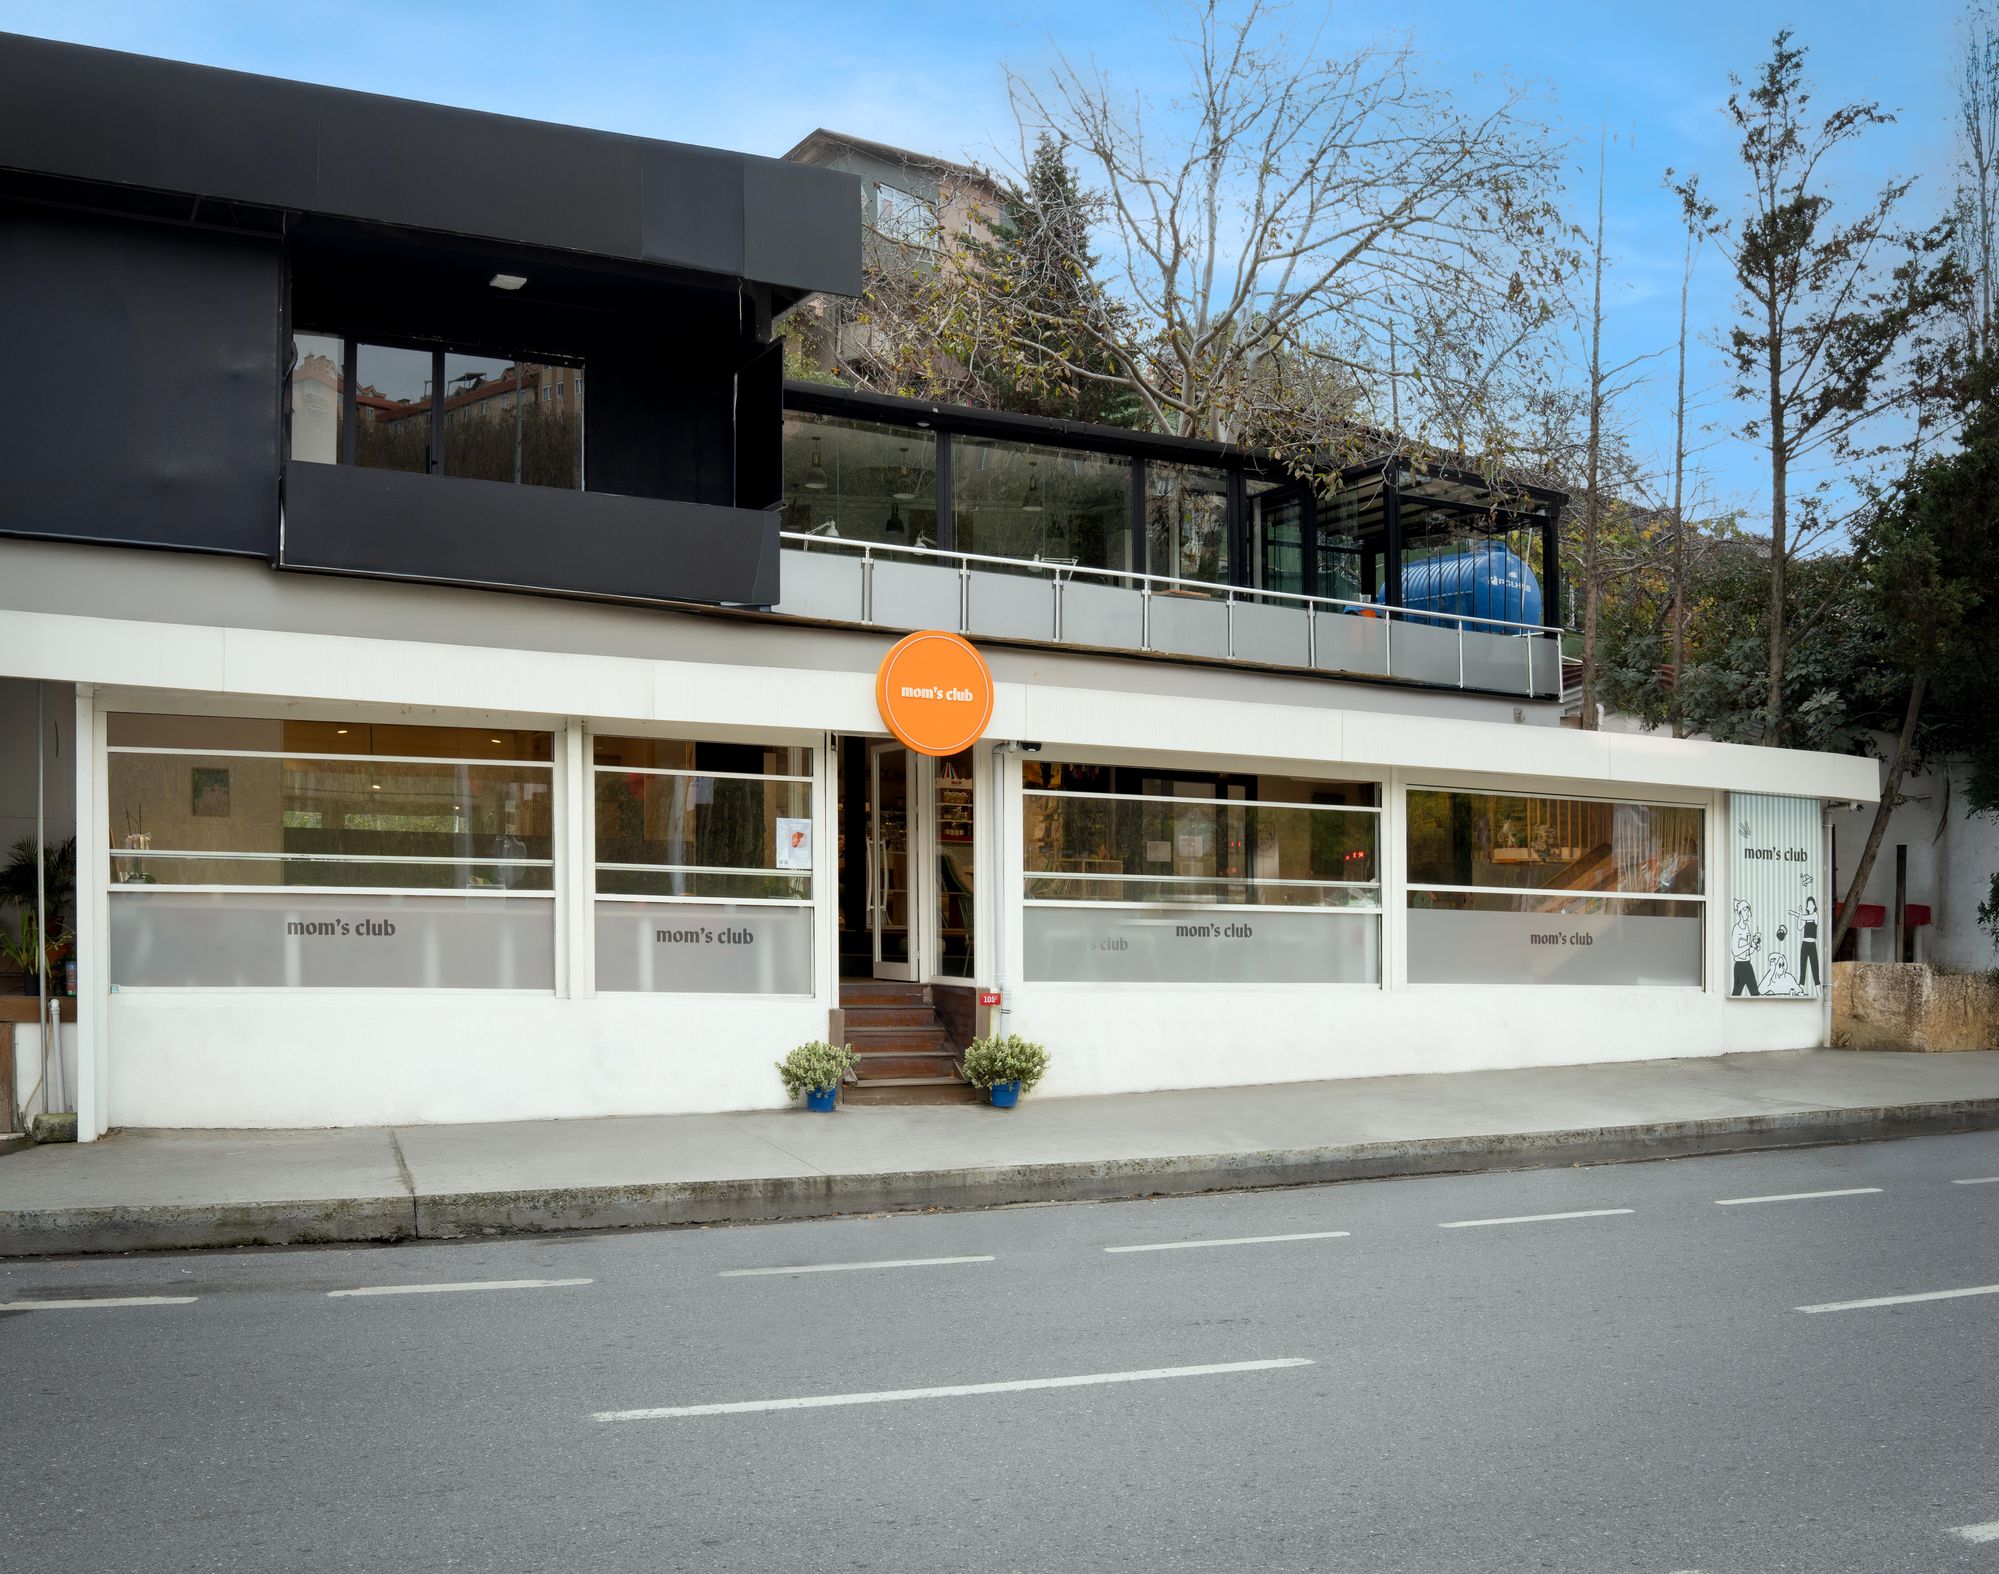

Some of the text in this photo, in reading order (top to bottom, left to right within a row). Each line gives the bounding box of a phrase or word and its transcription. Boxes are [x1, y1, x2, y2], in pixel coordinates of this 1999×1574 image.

[901, 686, 974, 702] mom's club
[1744, 846, 1808, 862] mom's club
[287, 918, 396, 937] mom's club
[1176, 923, 1253, 938] mom's club
[656, 927, 754, 945] mom's club
[1529, 932, 1594, 946] mom's club
